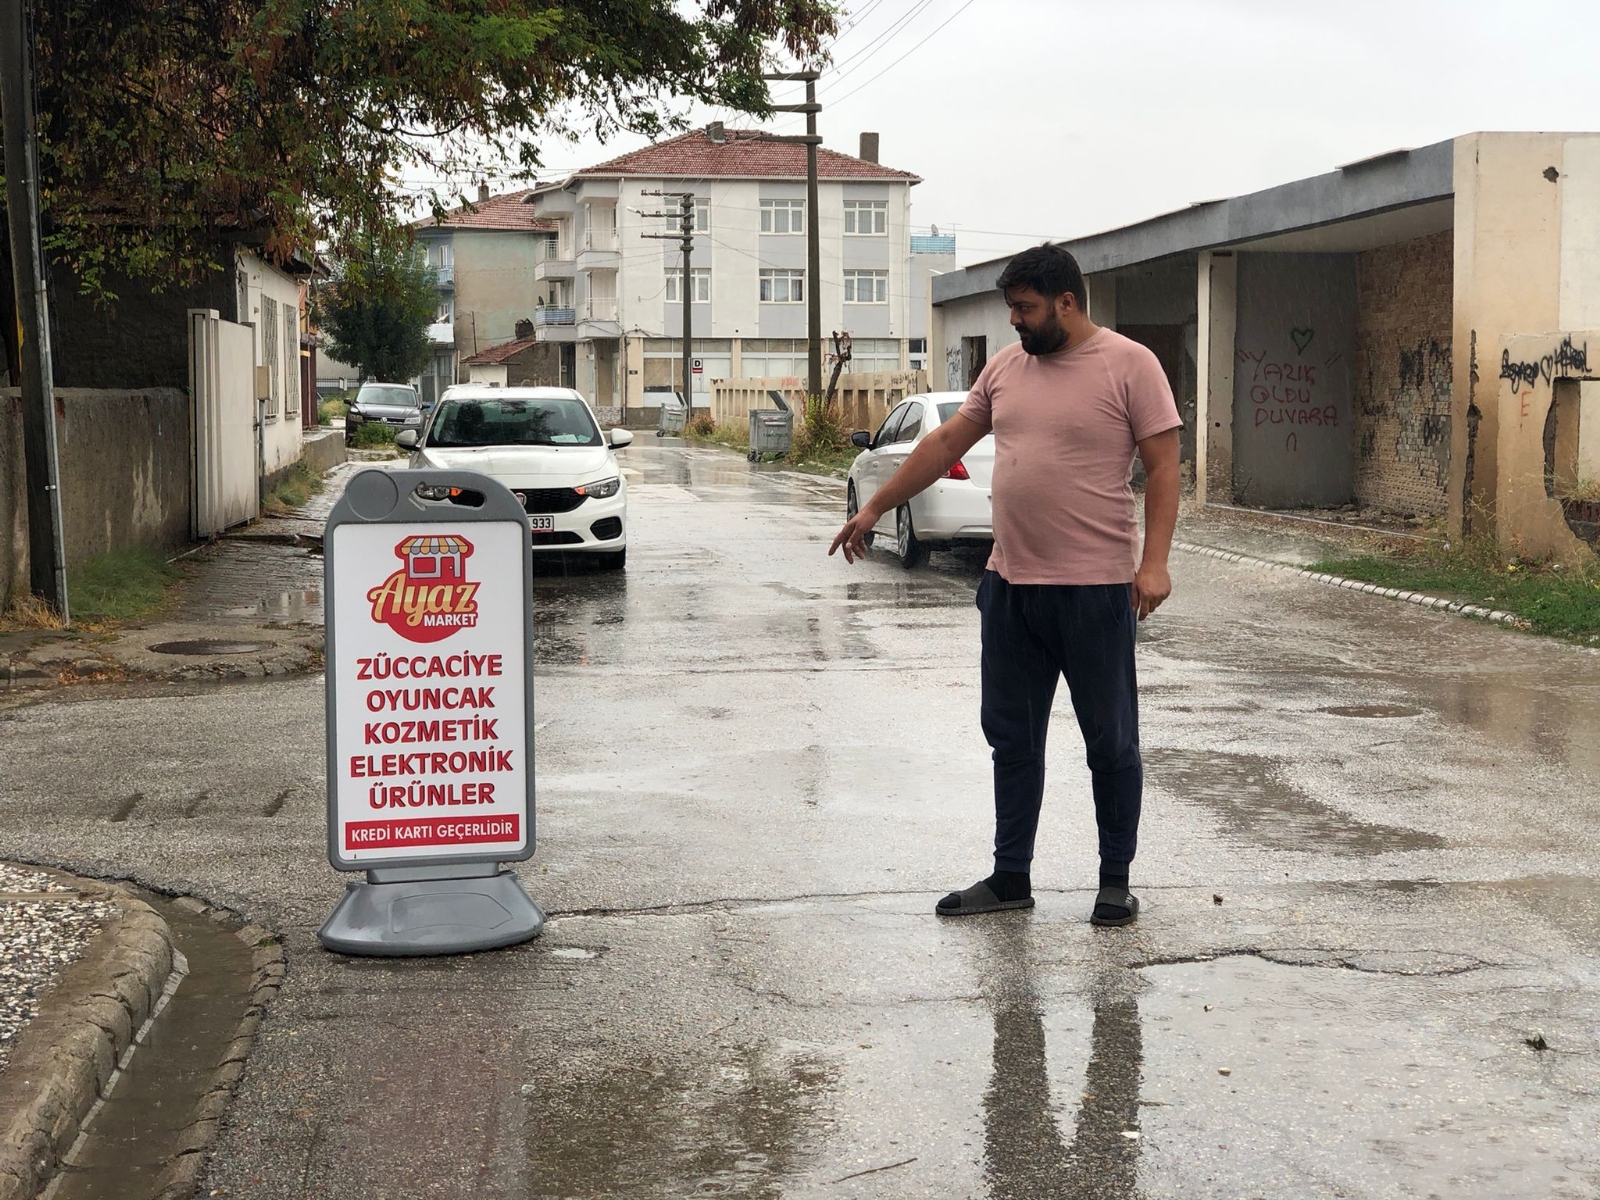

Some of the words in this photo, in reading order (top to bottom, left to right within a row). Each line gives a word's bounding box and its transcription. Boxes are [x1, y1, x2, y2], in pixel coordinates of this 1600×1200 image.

[1254, 405, 1339, 427] DUVARA
[532, 518, 551, 529] 933
[369, 573, 479, 627] Ayaz
[424, 613, 477, 627] MARKET
[356, 650, 503, 680] ZÜCCACİYE
[366, 686, 496, 712] OYUNCAK
[364, 714, 499, 744] KOZMETİK
[350, 745, 514, 777] ELEKTRONİK
[369, 780, 496, 809] ÜRÜNLER
[351, 824, 391, 842] KREDİ
[395, 825, 433, 840] KARTI
[436, 819, 513, 840] GEÇERLİDİR
